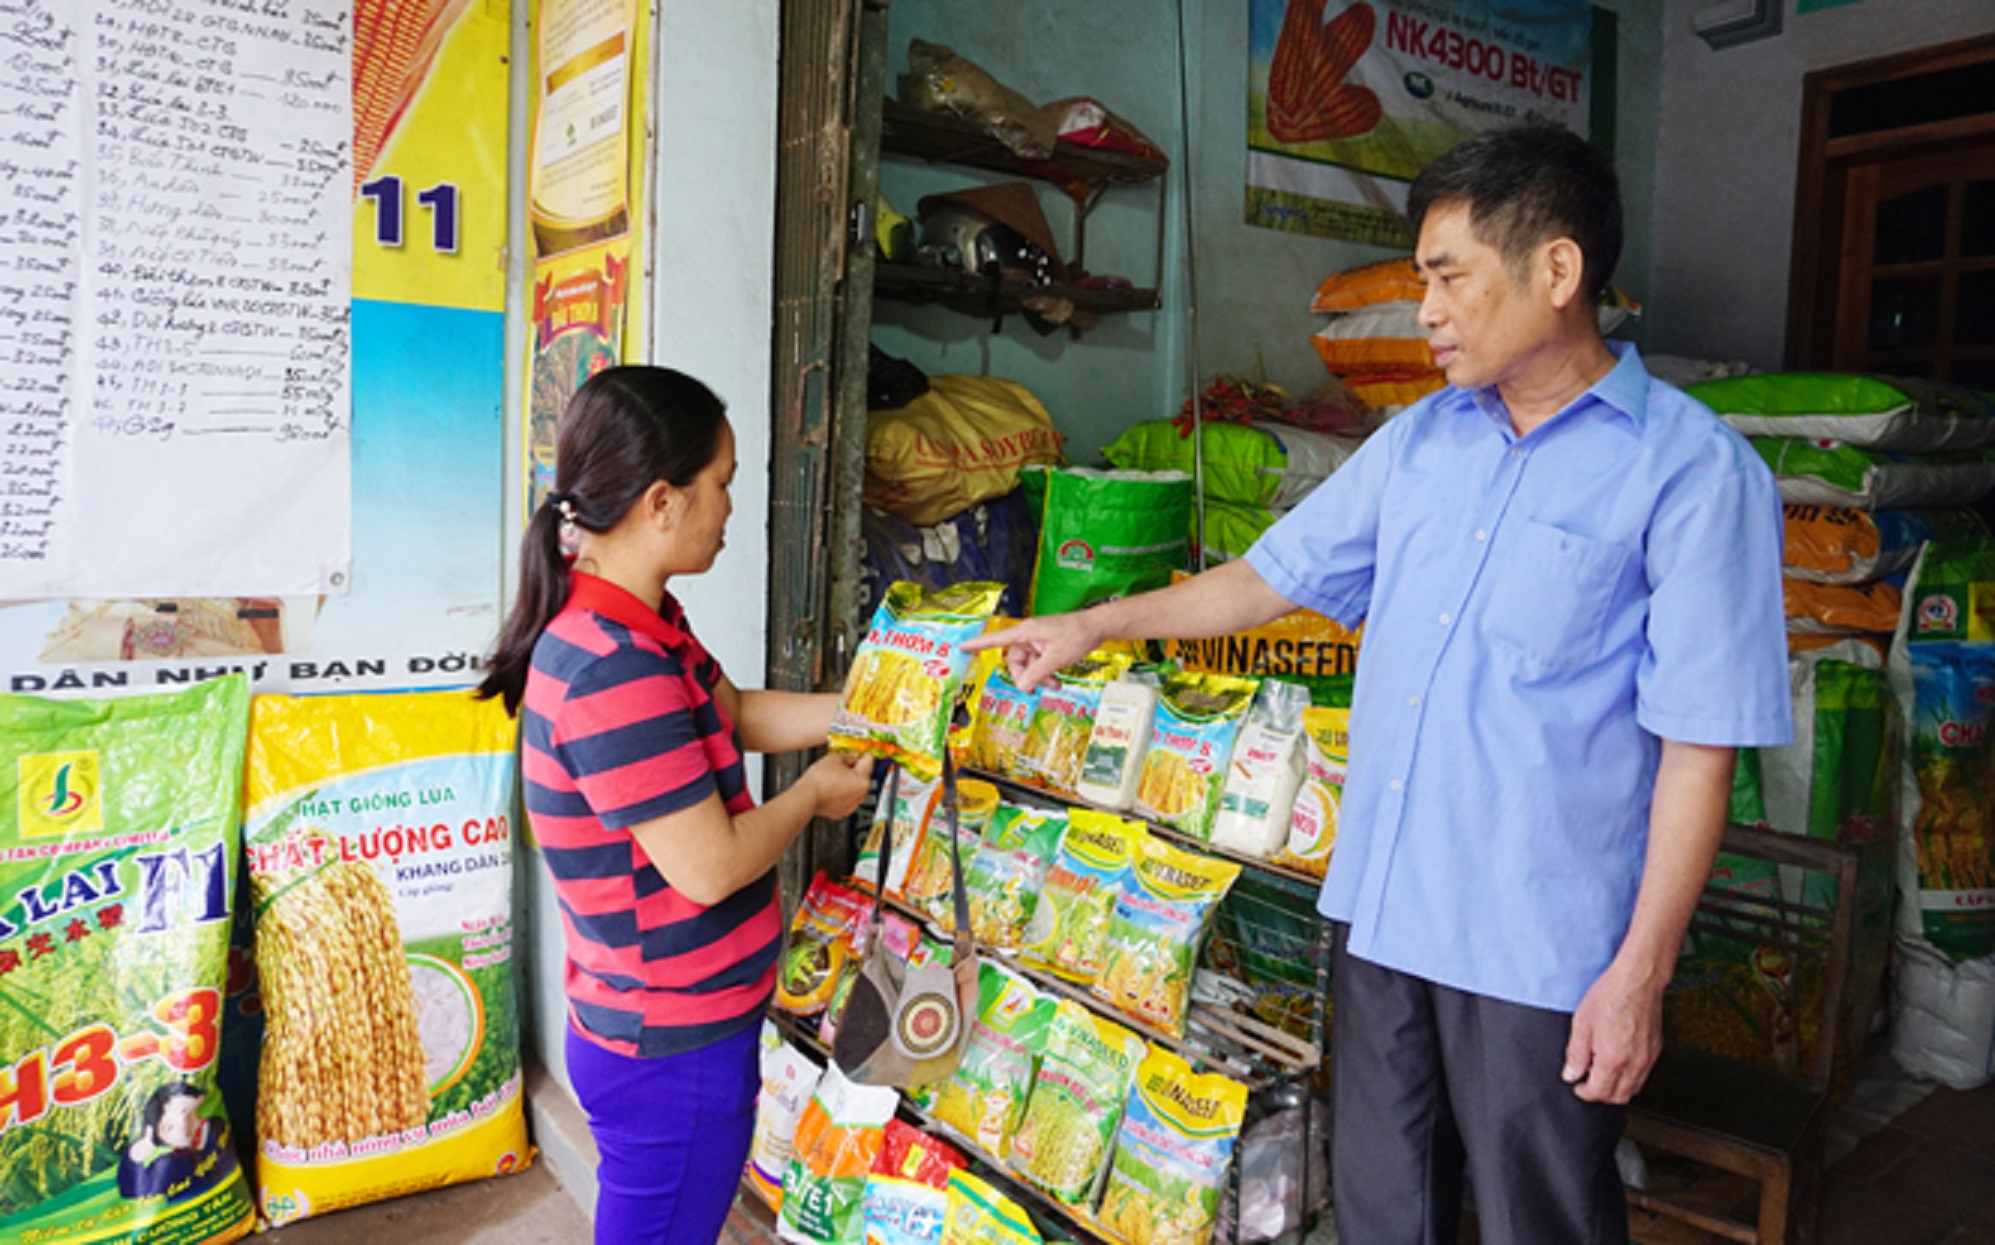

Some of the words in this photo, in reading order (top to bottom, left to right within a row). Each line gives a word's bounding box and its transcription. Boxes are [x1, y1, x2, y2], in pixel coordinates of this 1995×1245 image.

[1386, 11, 1505, 81] NK4300
[1511, 52, 1582, 103] Bt/GT
[360, 175, 460, 251] 11
[11, 669, 129, 692] DÂN
[289, 659, 386, 682] BẠN
[1201, 635, 1359, 677] VINASEED
[339, 823, 453, 866] LƯỢNG
[20, 862, 121, 923] LAI
[134, 841, 232, 934] F1
[395, 860, 463, 882] KHANG
